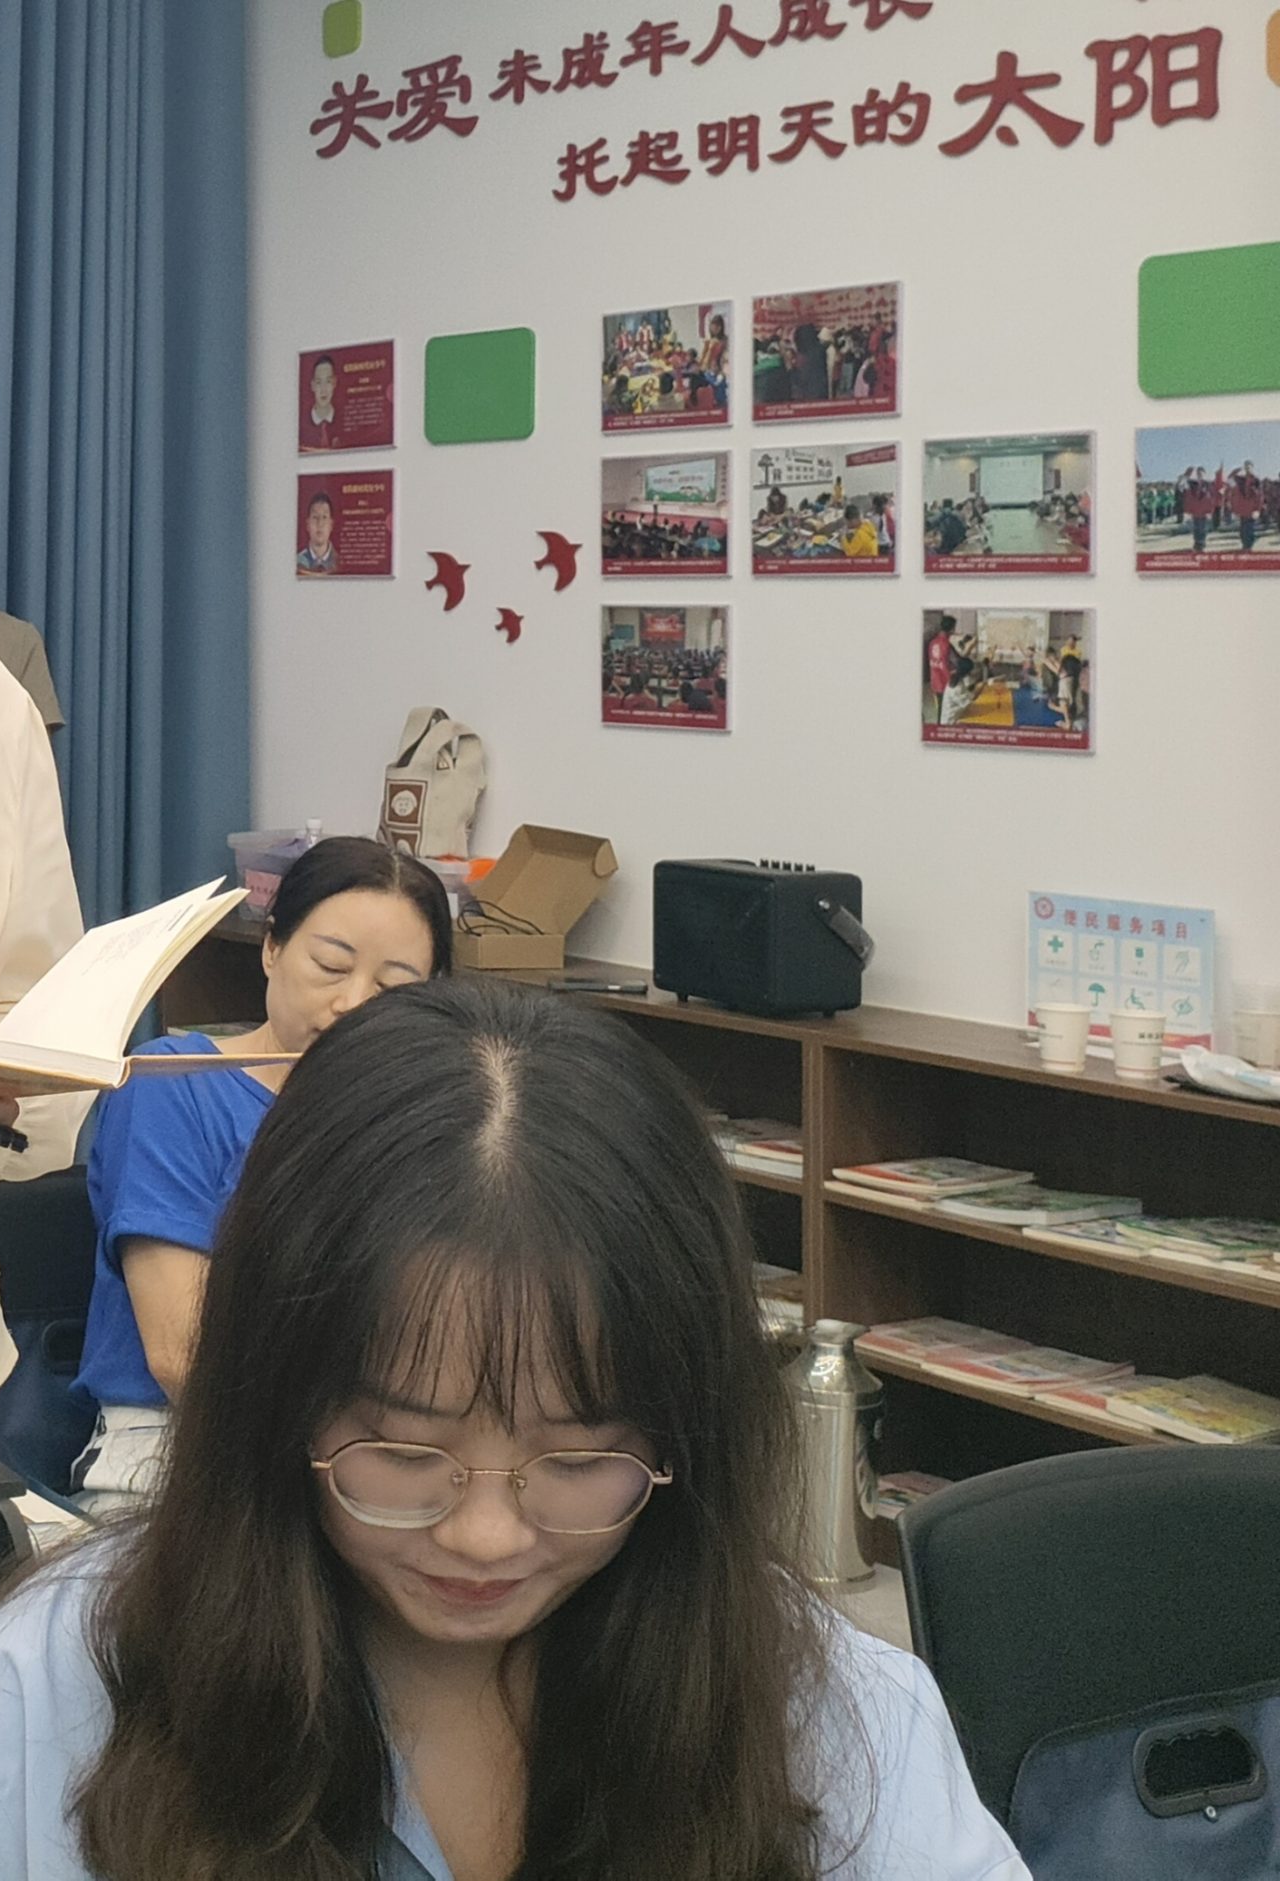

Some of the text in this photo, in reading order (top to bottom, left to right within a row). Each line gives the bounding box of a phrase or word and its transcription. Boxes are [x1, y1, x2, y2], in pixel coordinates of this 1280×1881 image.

[552, 27, 1223, 202] 托起明天的太阳
